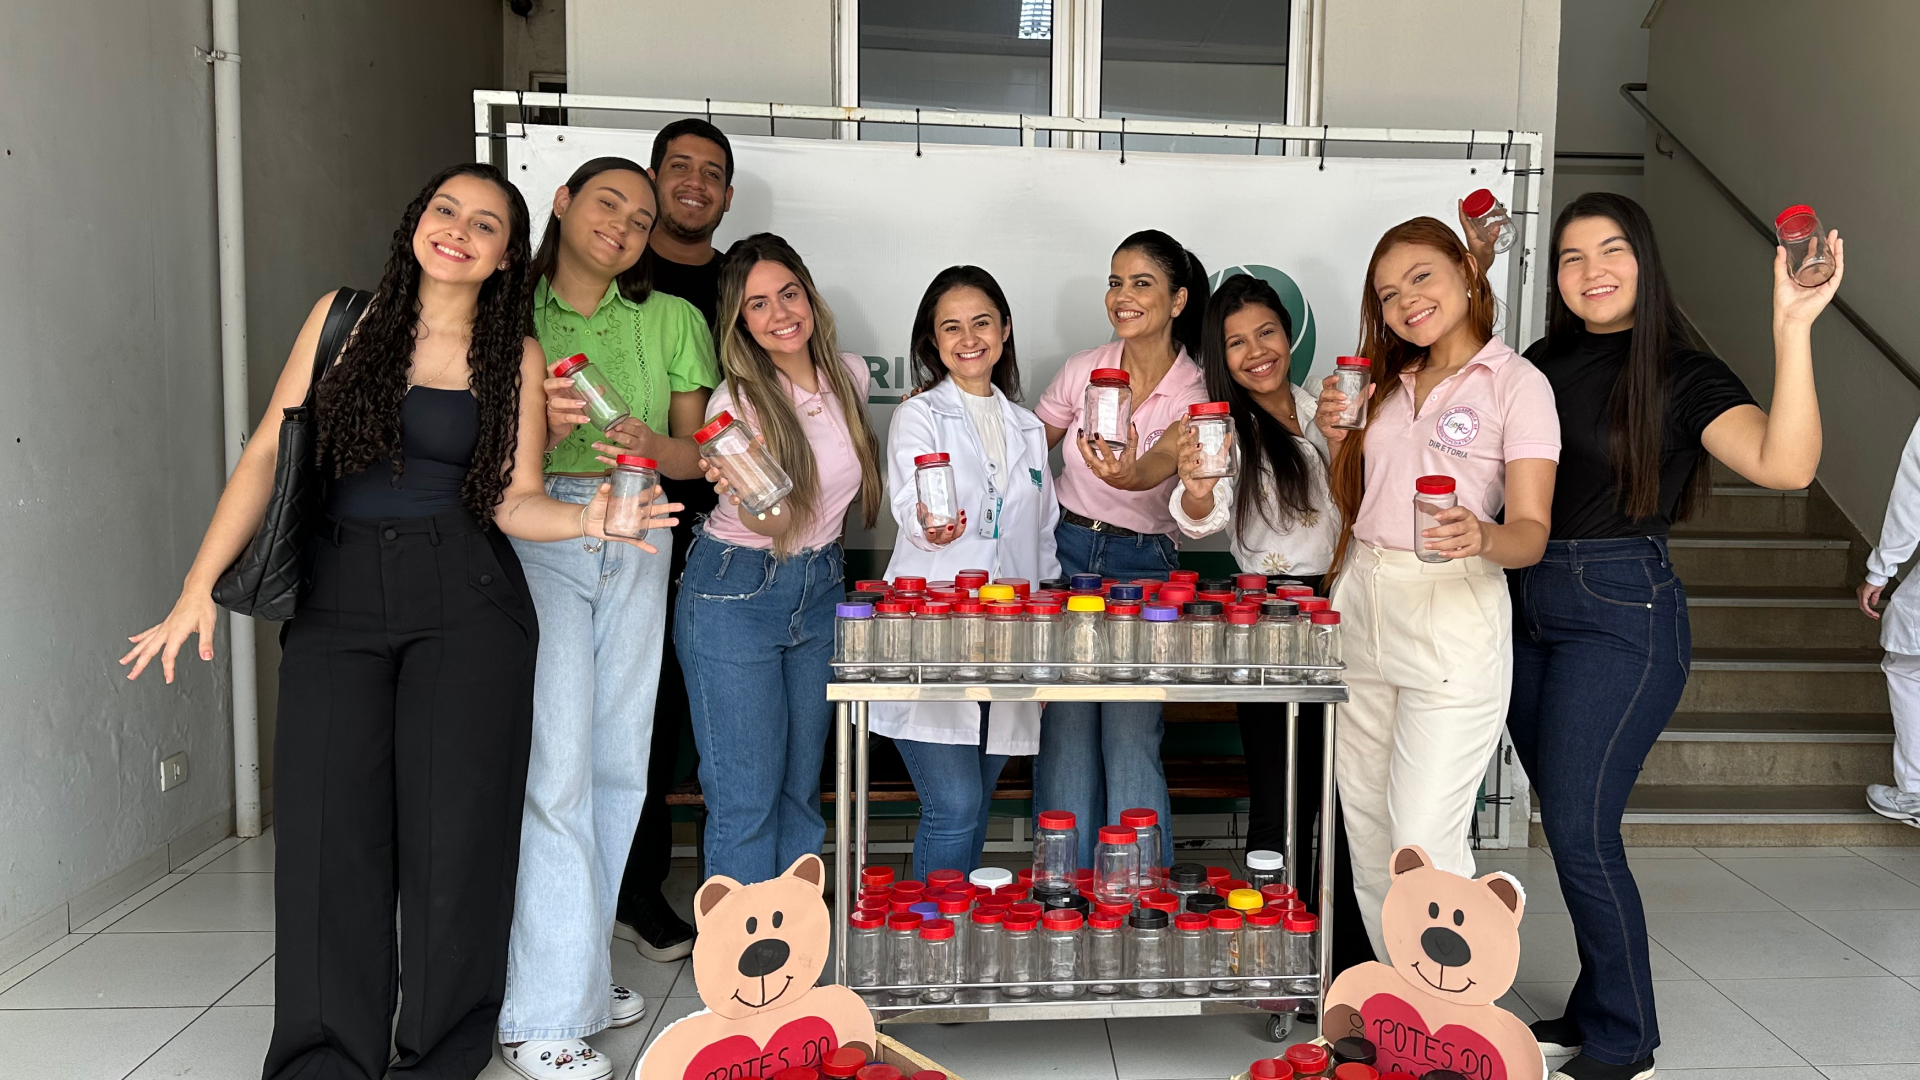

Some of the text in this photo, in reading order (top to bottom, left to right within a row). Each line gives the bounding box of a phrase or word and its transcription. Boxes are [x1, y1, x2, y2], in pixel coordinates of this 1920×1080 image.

[1428, 439, 1468, 459] DIRETORIA
[1373, 1018, 1455, 1069] POTES
[1460, 1048, 1493, 1080] DO
